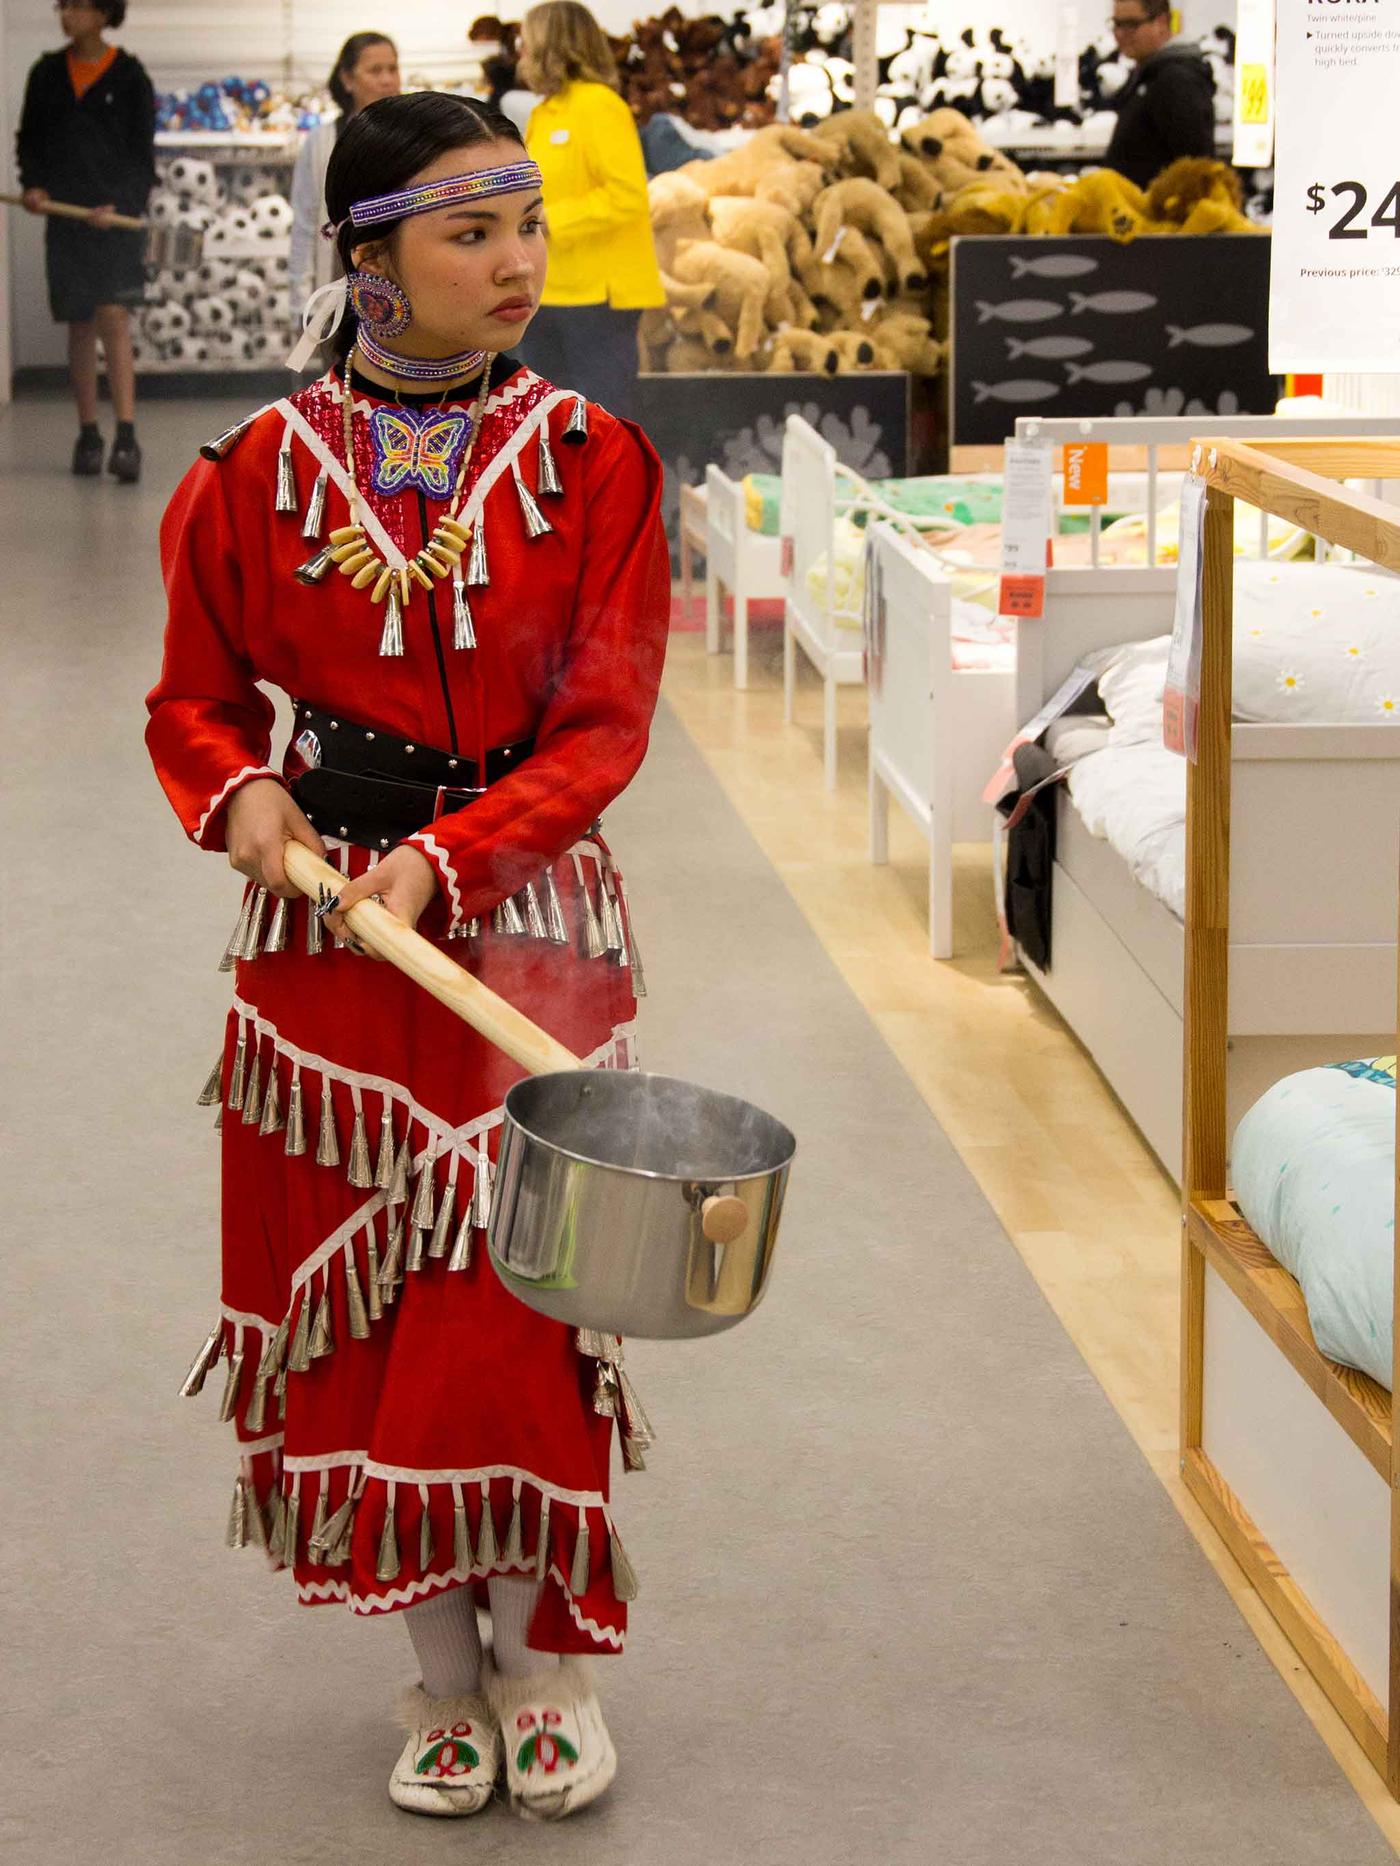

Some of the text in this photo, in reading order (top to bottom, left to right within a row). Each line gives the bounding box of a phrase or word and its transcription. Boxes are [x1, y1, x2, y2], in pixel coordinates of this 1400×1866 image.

[1307, 13, 1377, 23] Twin white/pine
[1315, 30, 1349, 39] Turned
[1351, 30, 1383, 41] upside
[1315, 44, 1348, 55] quickly
[1350, 44, 1391, 53] converts
[1314, 58, 1357, 69] high bed
[1306, 181, 1400, 239] $24
[1300, 268, 1347, 277] Previous
[1349, 267, 1379, 279] price:
[1068, 448, 1085, 491] New
